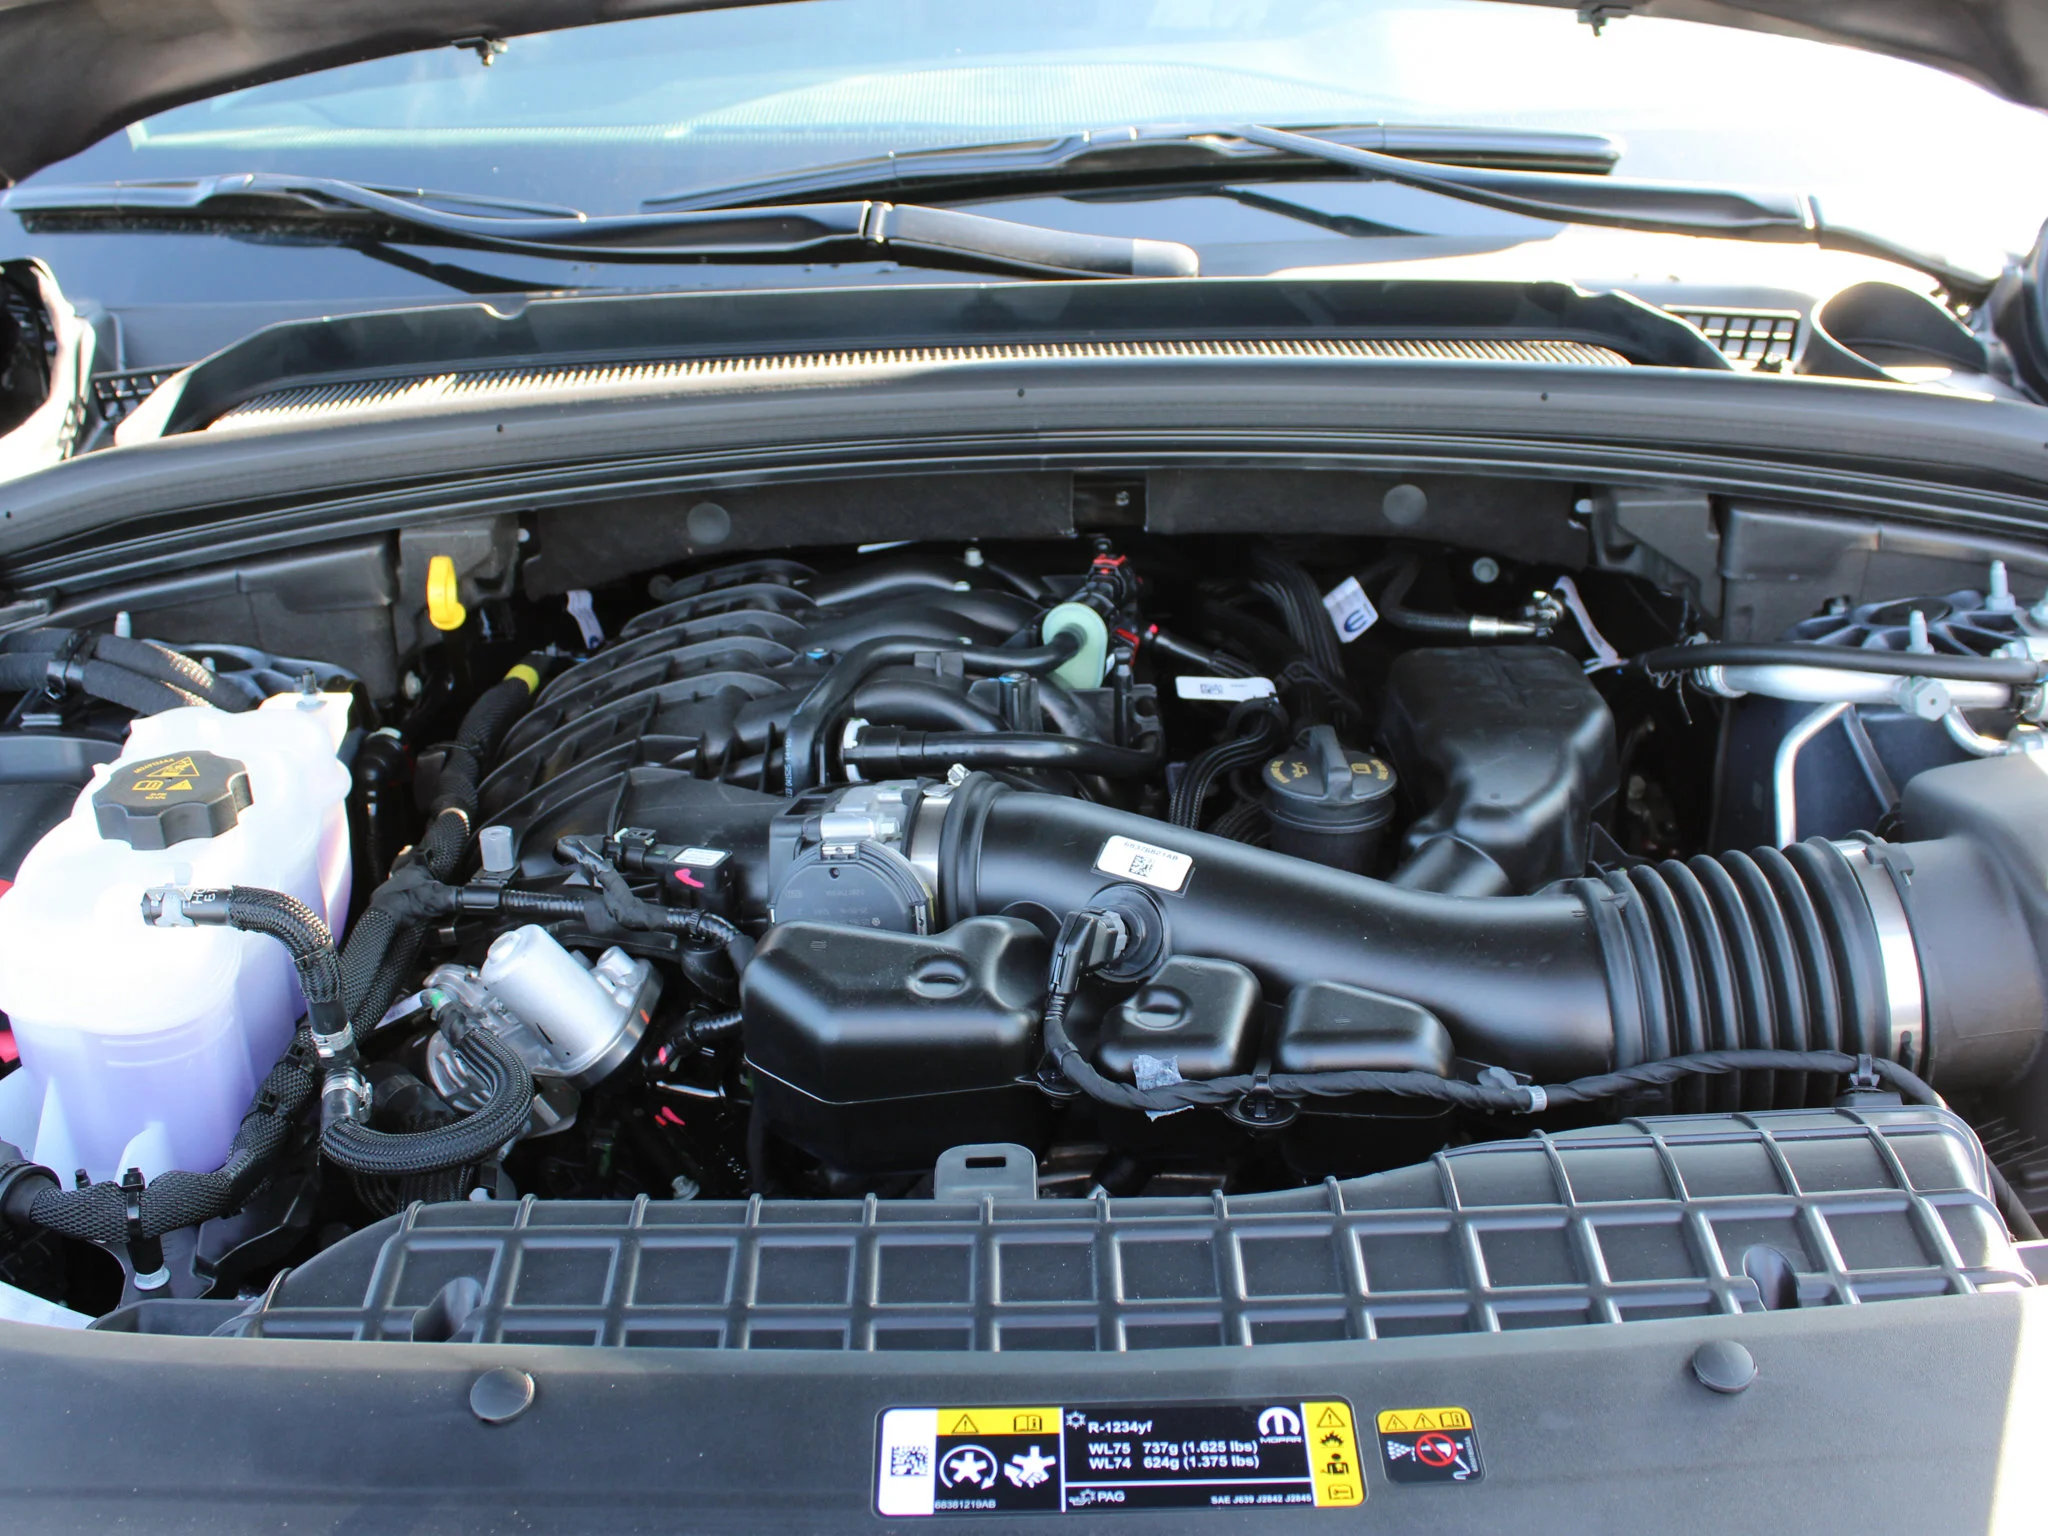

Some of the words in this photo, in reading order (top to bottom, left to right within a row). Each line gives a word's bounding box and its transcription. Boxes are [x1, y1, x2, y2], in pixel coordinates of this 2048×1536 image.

[1087, 1420, 1153, 1435] R-1234yf
[1259, 1436, 1302, 1444] MOPAR
[1088, 1442, 1131, 1455] WL75
[1142, 1441, 1179, 1456] 737g
[1182, 1440, 1227, 1456] (1.625
[1229, 1440, 1258, 1455] lbs)
[1089, 1456, 1132, 1470] WL74
[1143, 1456, 1180, 1471] 624g
[1183, 1455, 1228, 1472] (1.375
[1231, 1455, 1260, 1470] lbs)
[1097, 1491, 1125, 1502] PAG
[1210, 1495, 1231, 1505] SAE
[1233, 1495, 1255, 1504] J639
